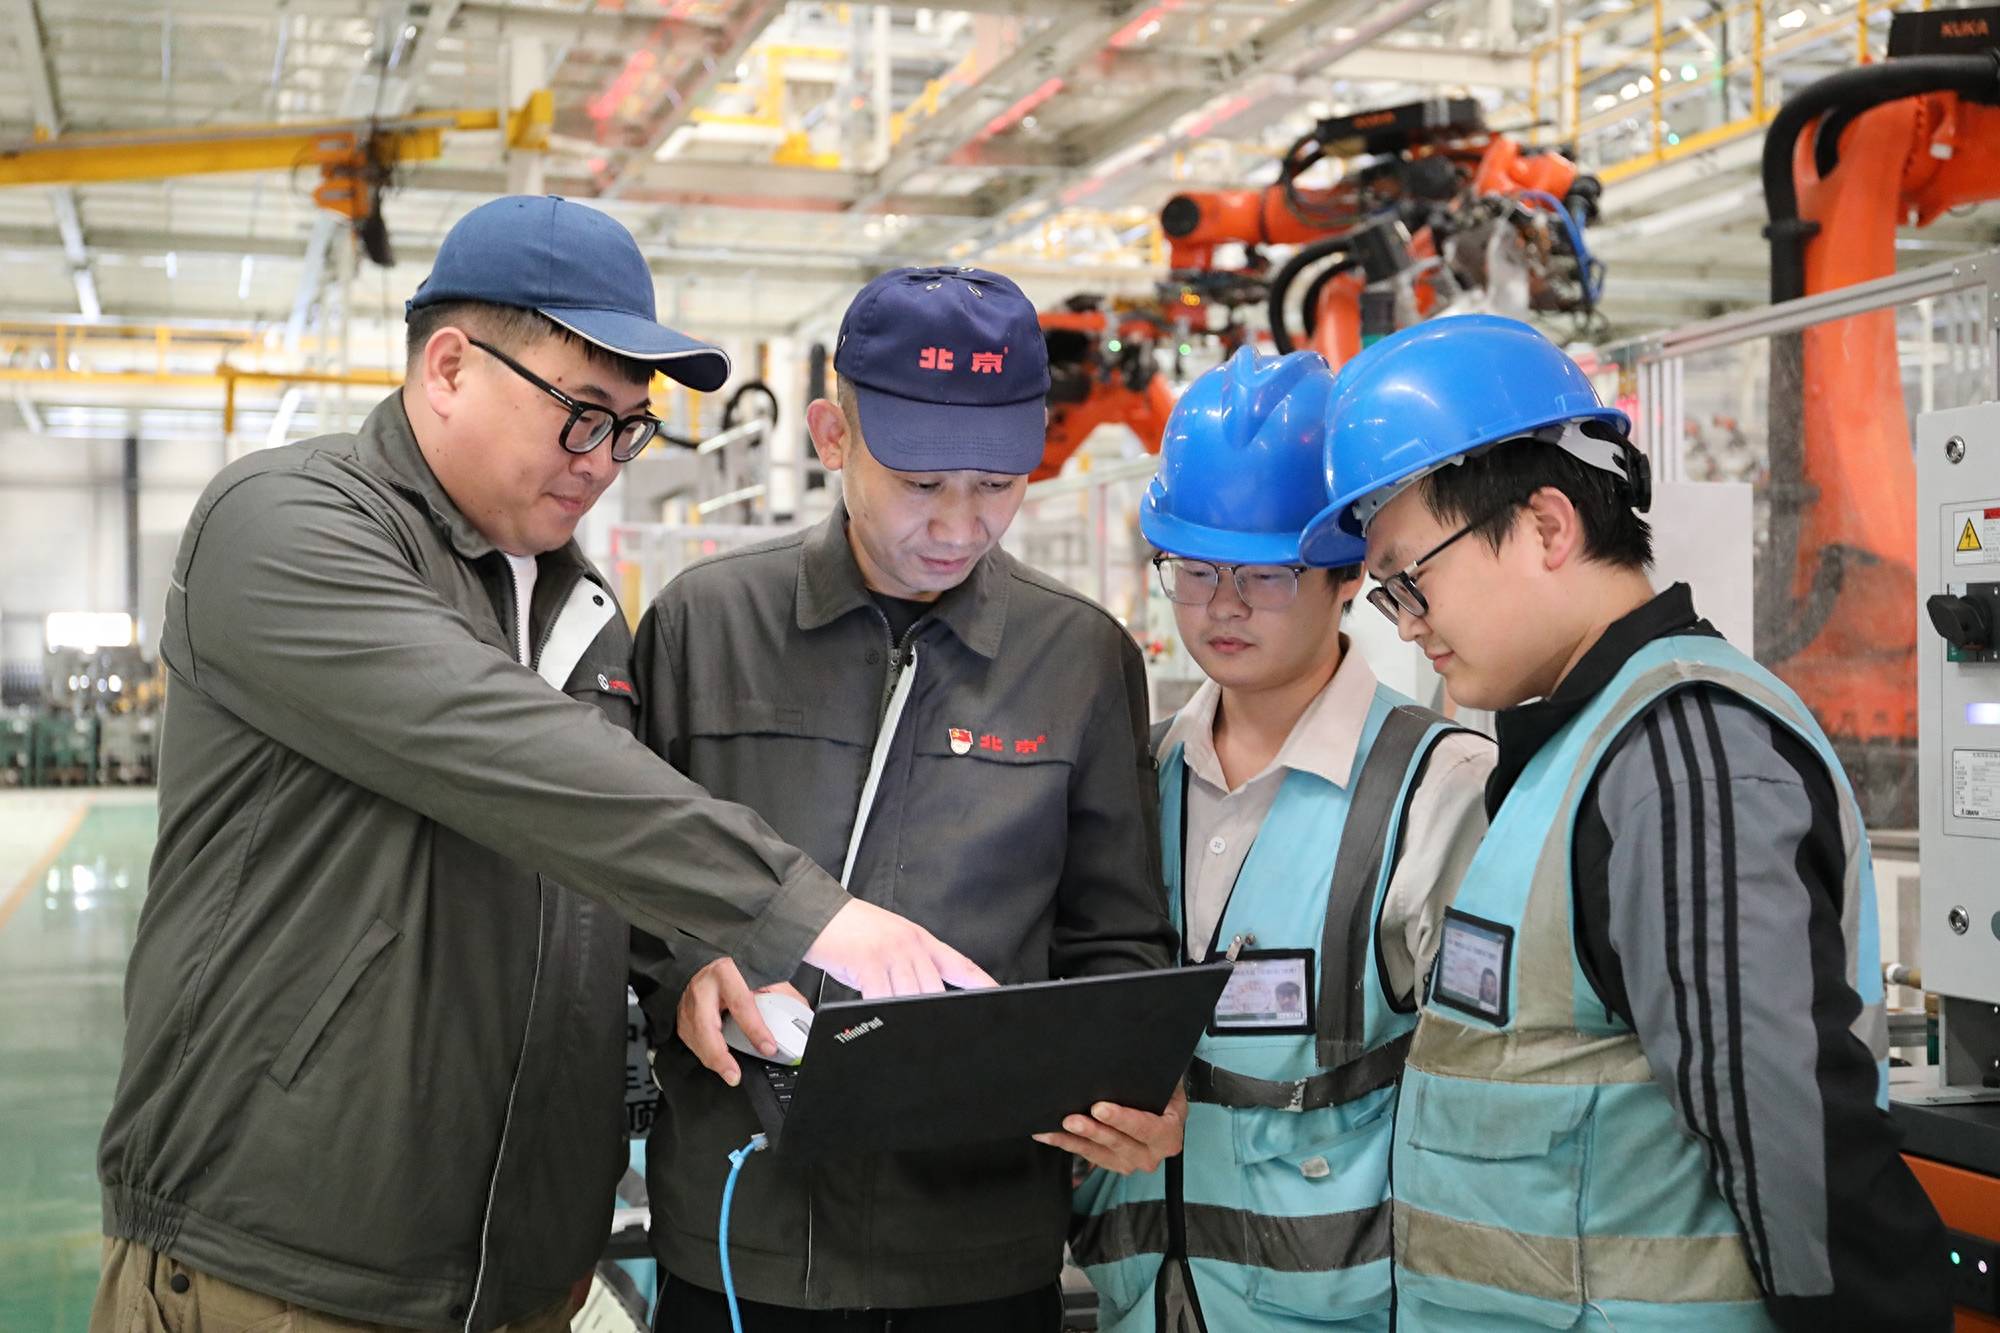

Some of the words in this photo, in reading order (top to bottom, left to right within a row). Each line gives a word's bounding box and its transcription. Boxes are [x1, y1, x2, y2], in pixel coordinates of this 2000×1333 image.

[919, 346, 1004, 374] 北京
[979, 735, 1039, 754] 北京
[834, 1016, 884, 1043] ThinkPad
